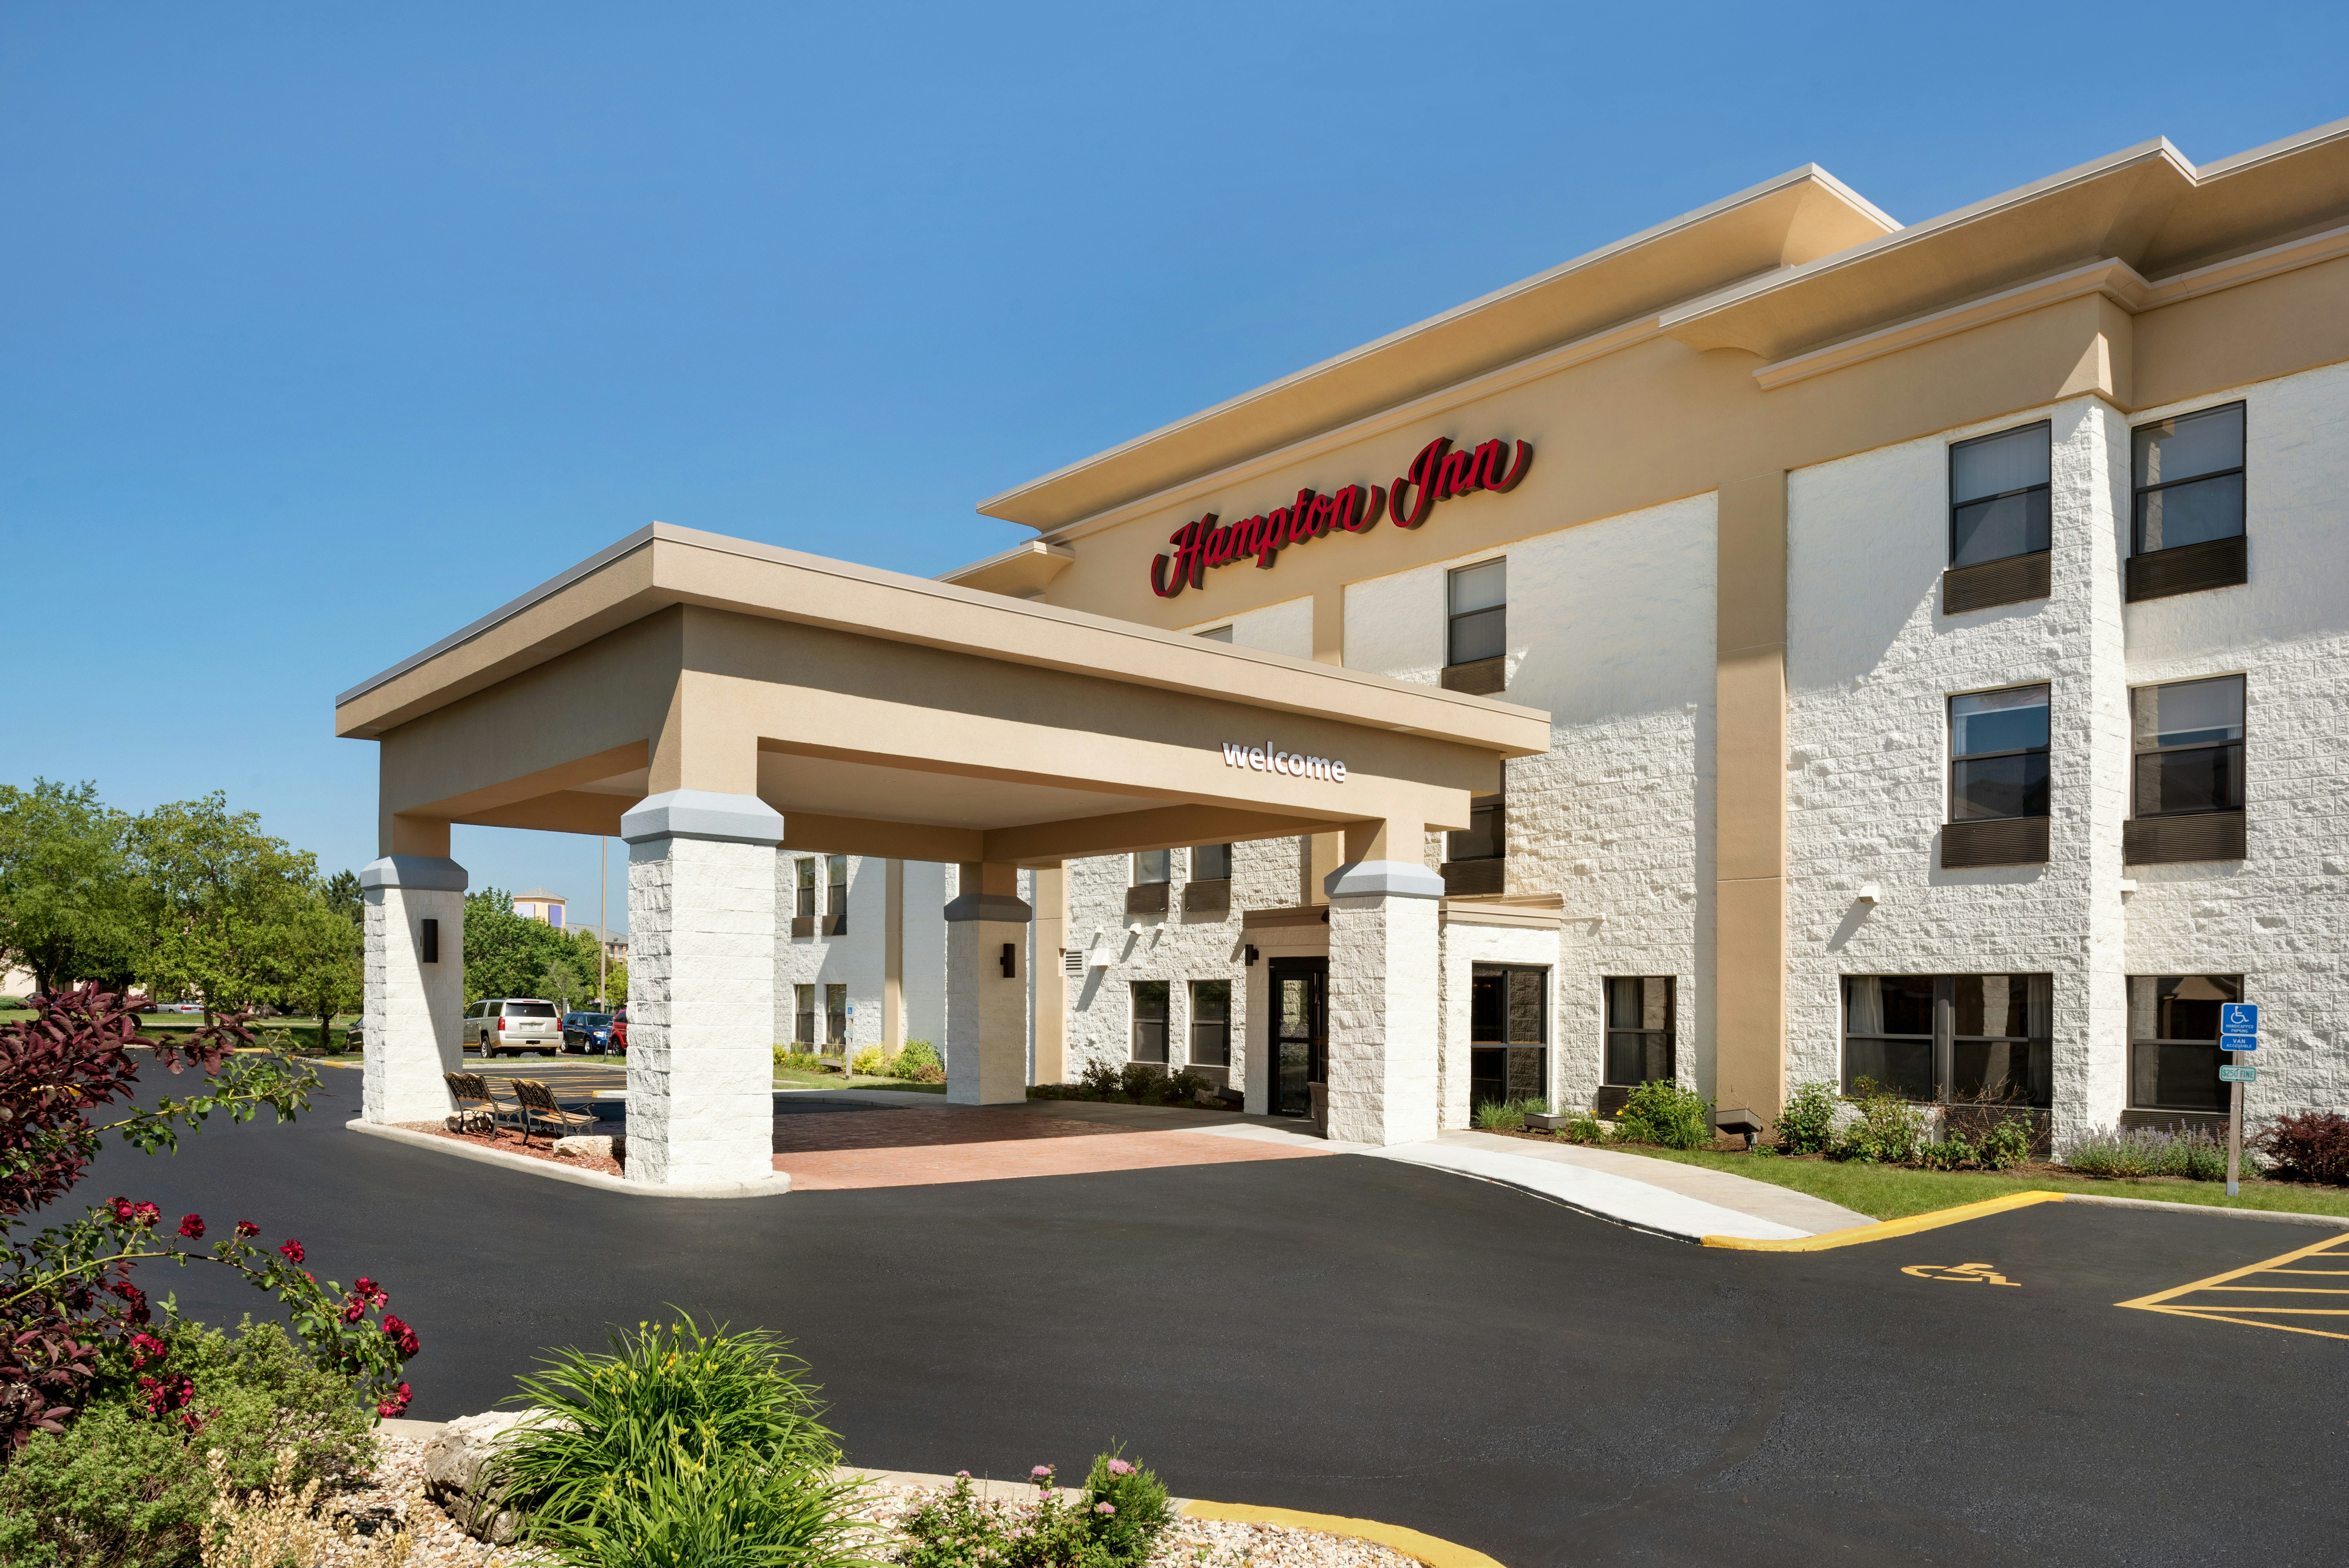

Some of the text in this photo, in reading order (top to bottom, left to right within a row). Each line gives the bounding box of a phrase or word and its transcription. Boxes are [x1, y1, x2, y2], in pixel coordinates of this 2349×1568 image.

[1151, 436, 1533, 598] Hampton Inn
[1221, 741, 1346, 782] welcome
[2222, 1069, 2254, 1078] $250 FINE
